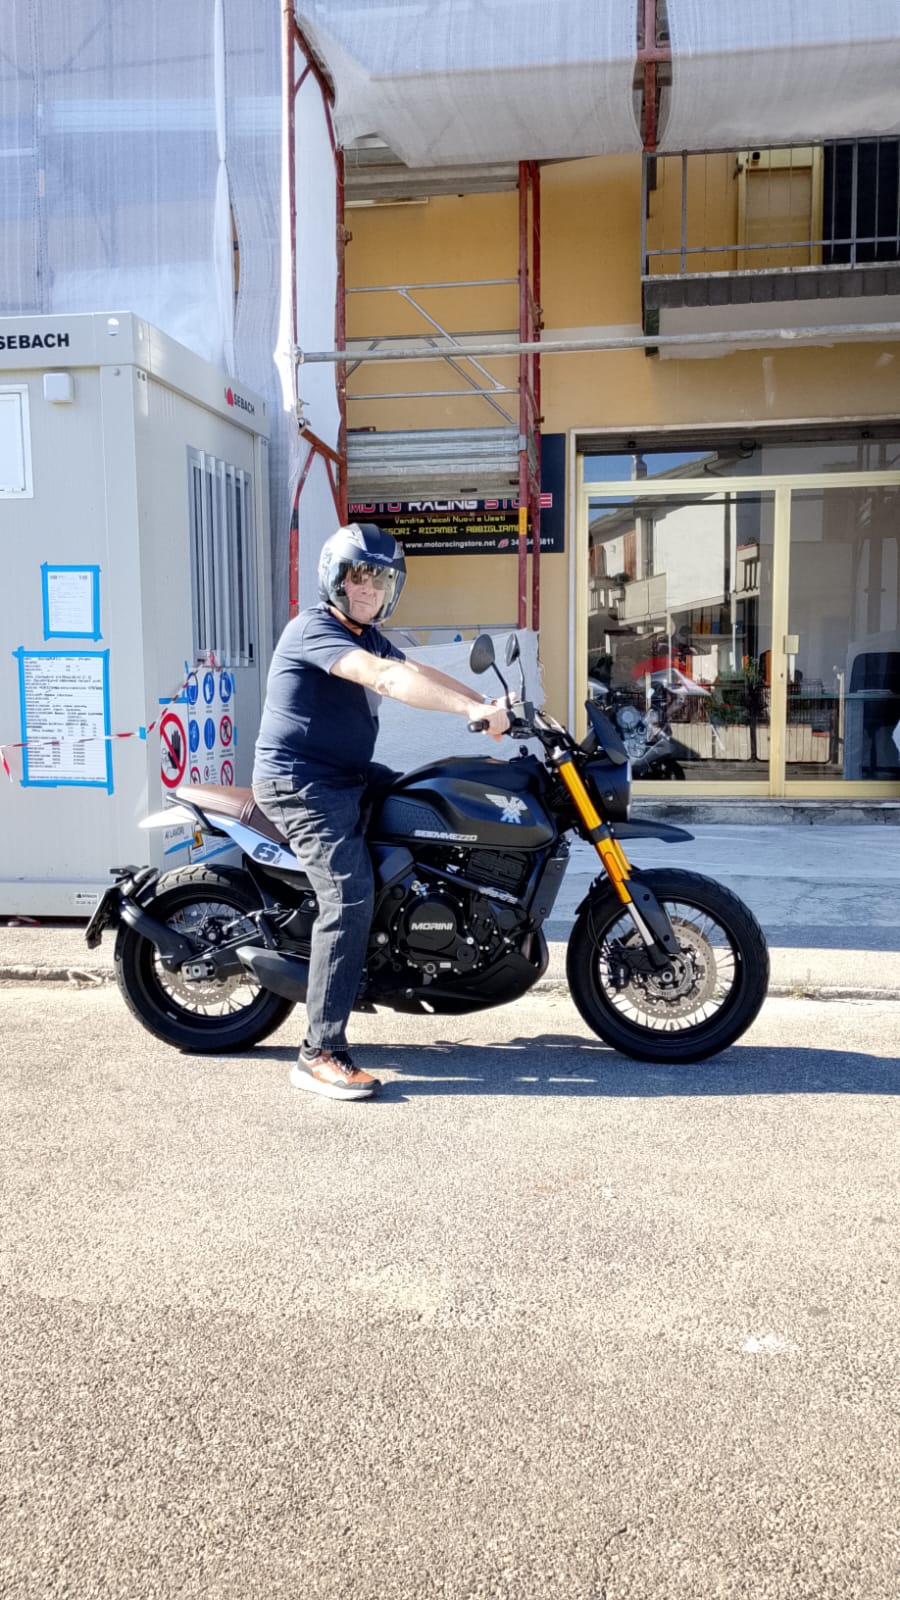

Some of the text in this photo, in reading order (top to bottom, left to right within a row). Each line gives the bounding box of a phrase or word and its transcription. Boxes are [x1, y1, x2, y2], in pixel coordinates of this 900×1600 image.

[233, 393, 255, 416] SEBACH
[408, 500, 478, 511] RACING
[395, 516, 424, 524] Vendita
[427, 515, 450, 524] Veicoli
[453, 514, 475, 523] Nuovi
[484, 514, 505, 522] Usati
[418, 526, 458, 535] RICAMBI
[405, 539, 496, 549] www.motoracingstore.net
[411, 922, 454, 931] MORINI
